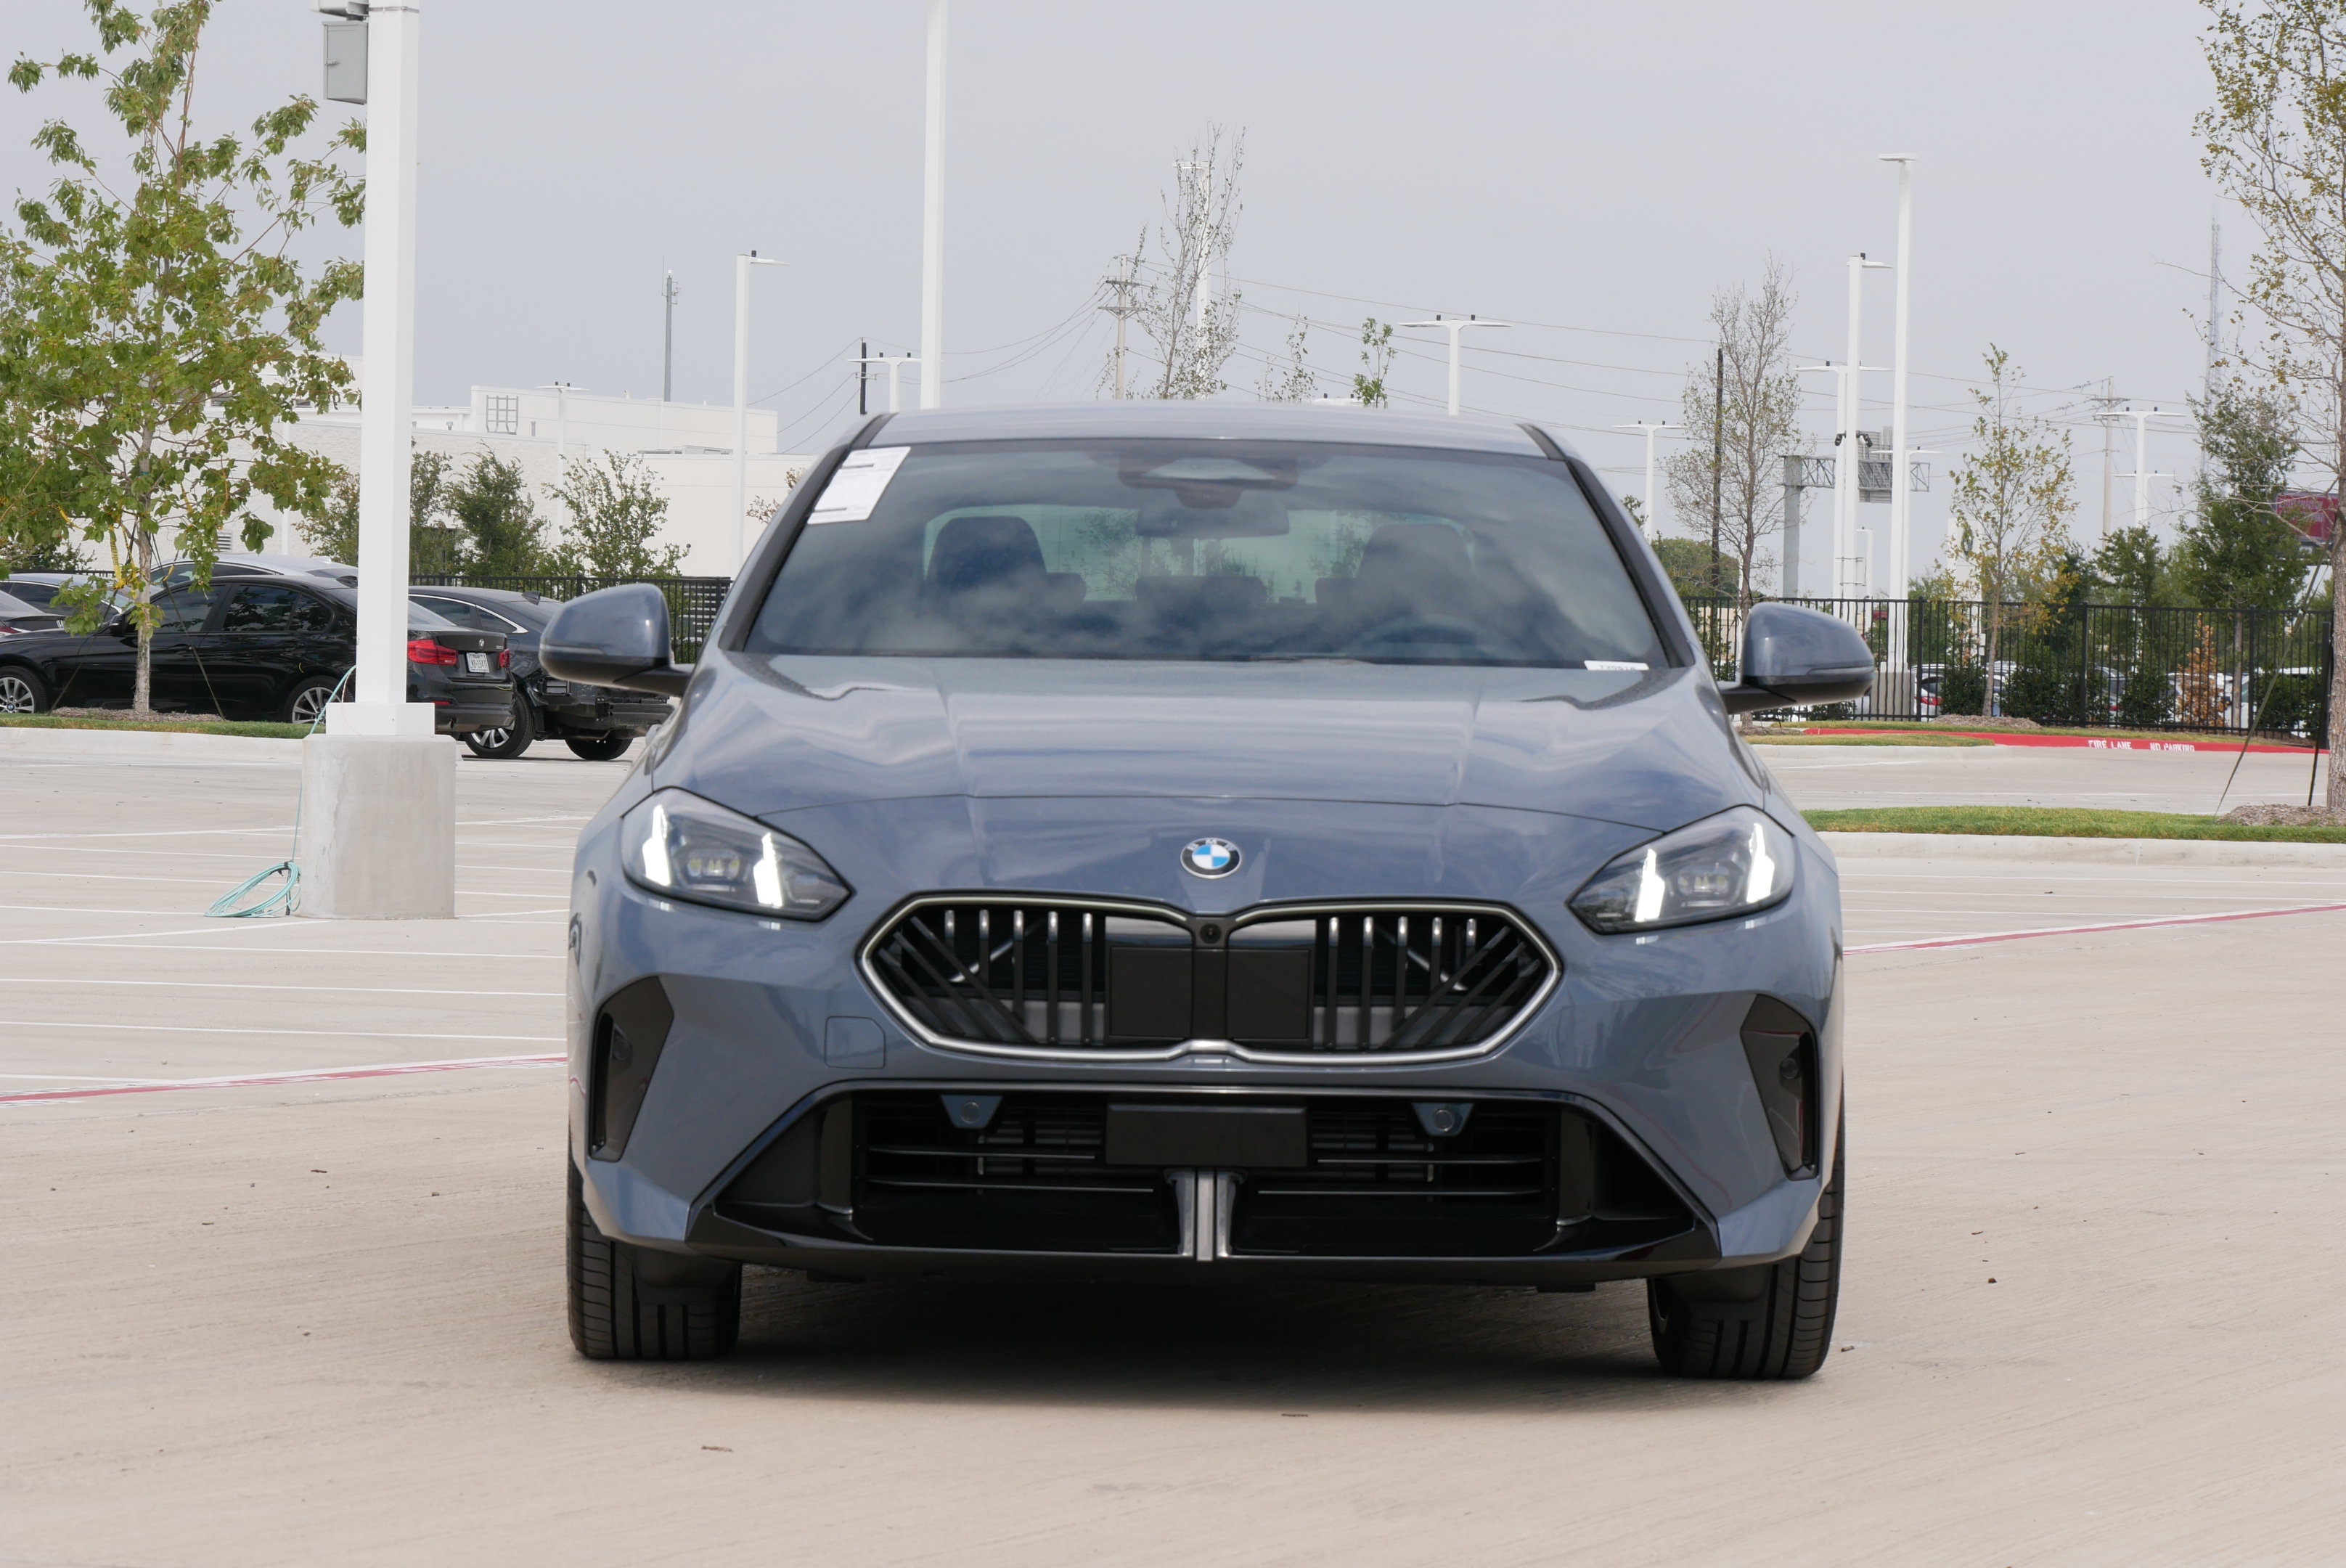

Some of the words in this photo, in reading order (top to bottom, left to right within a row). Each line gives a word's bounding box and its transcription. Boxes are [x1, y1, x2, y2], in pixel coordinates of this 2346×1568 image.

[2088, 740, 2108, 749] FIRE
[2110, 740, 2133, 750] LANE
[2149, 742, 2162, 751] NO
[2163, 743, 2196, 752] PARKING
